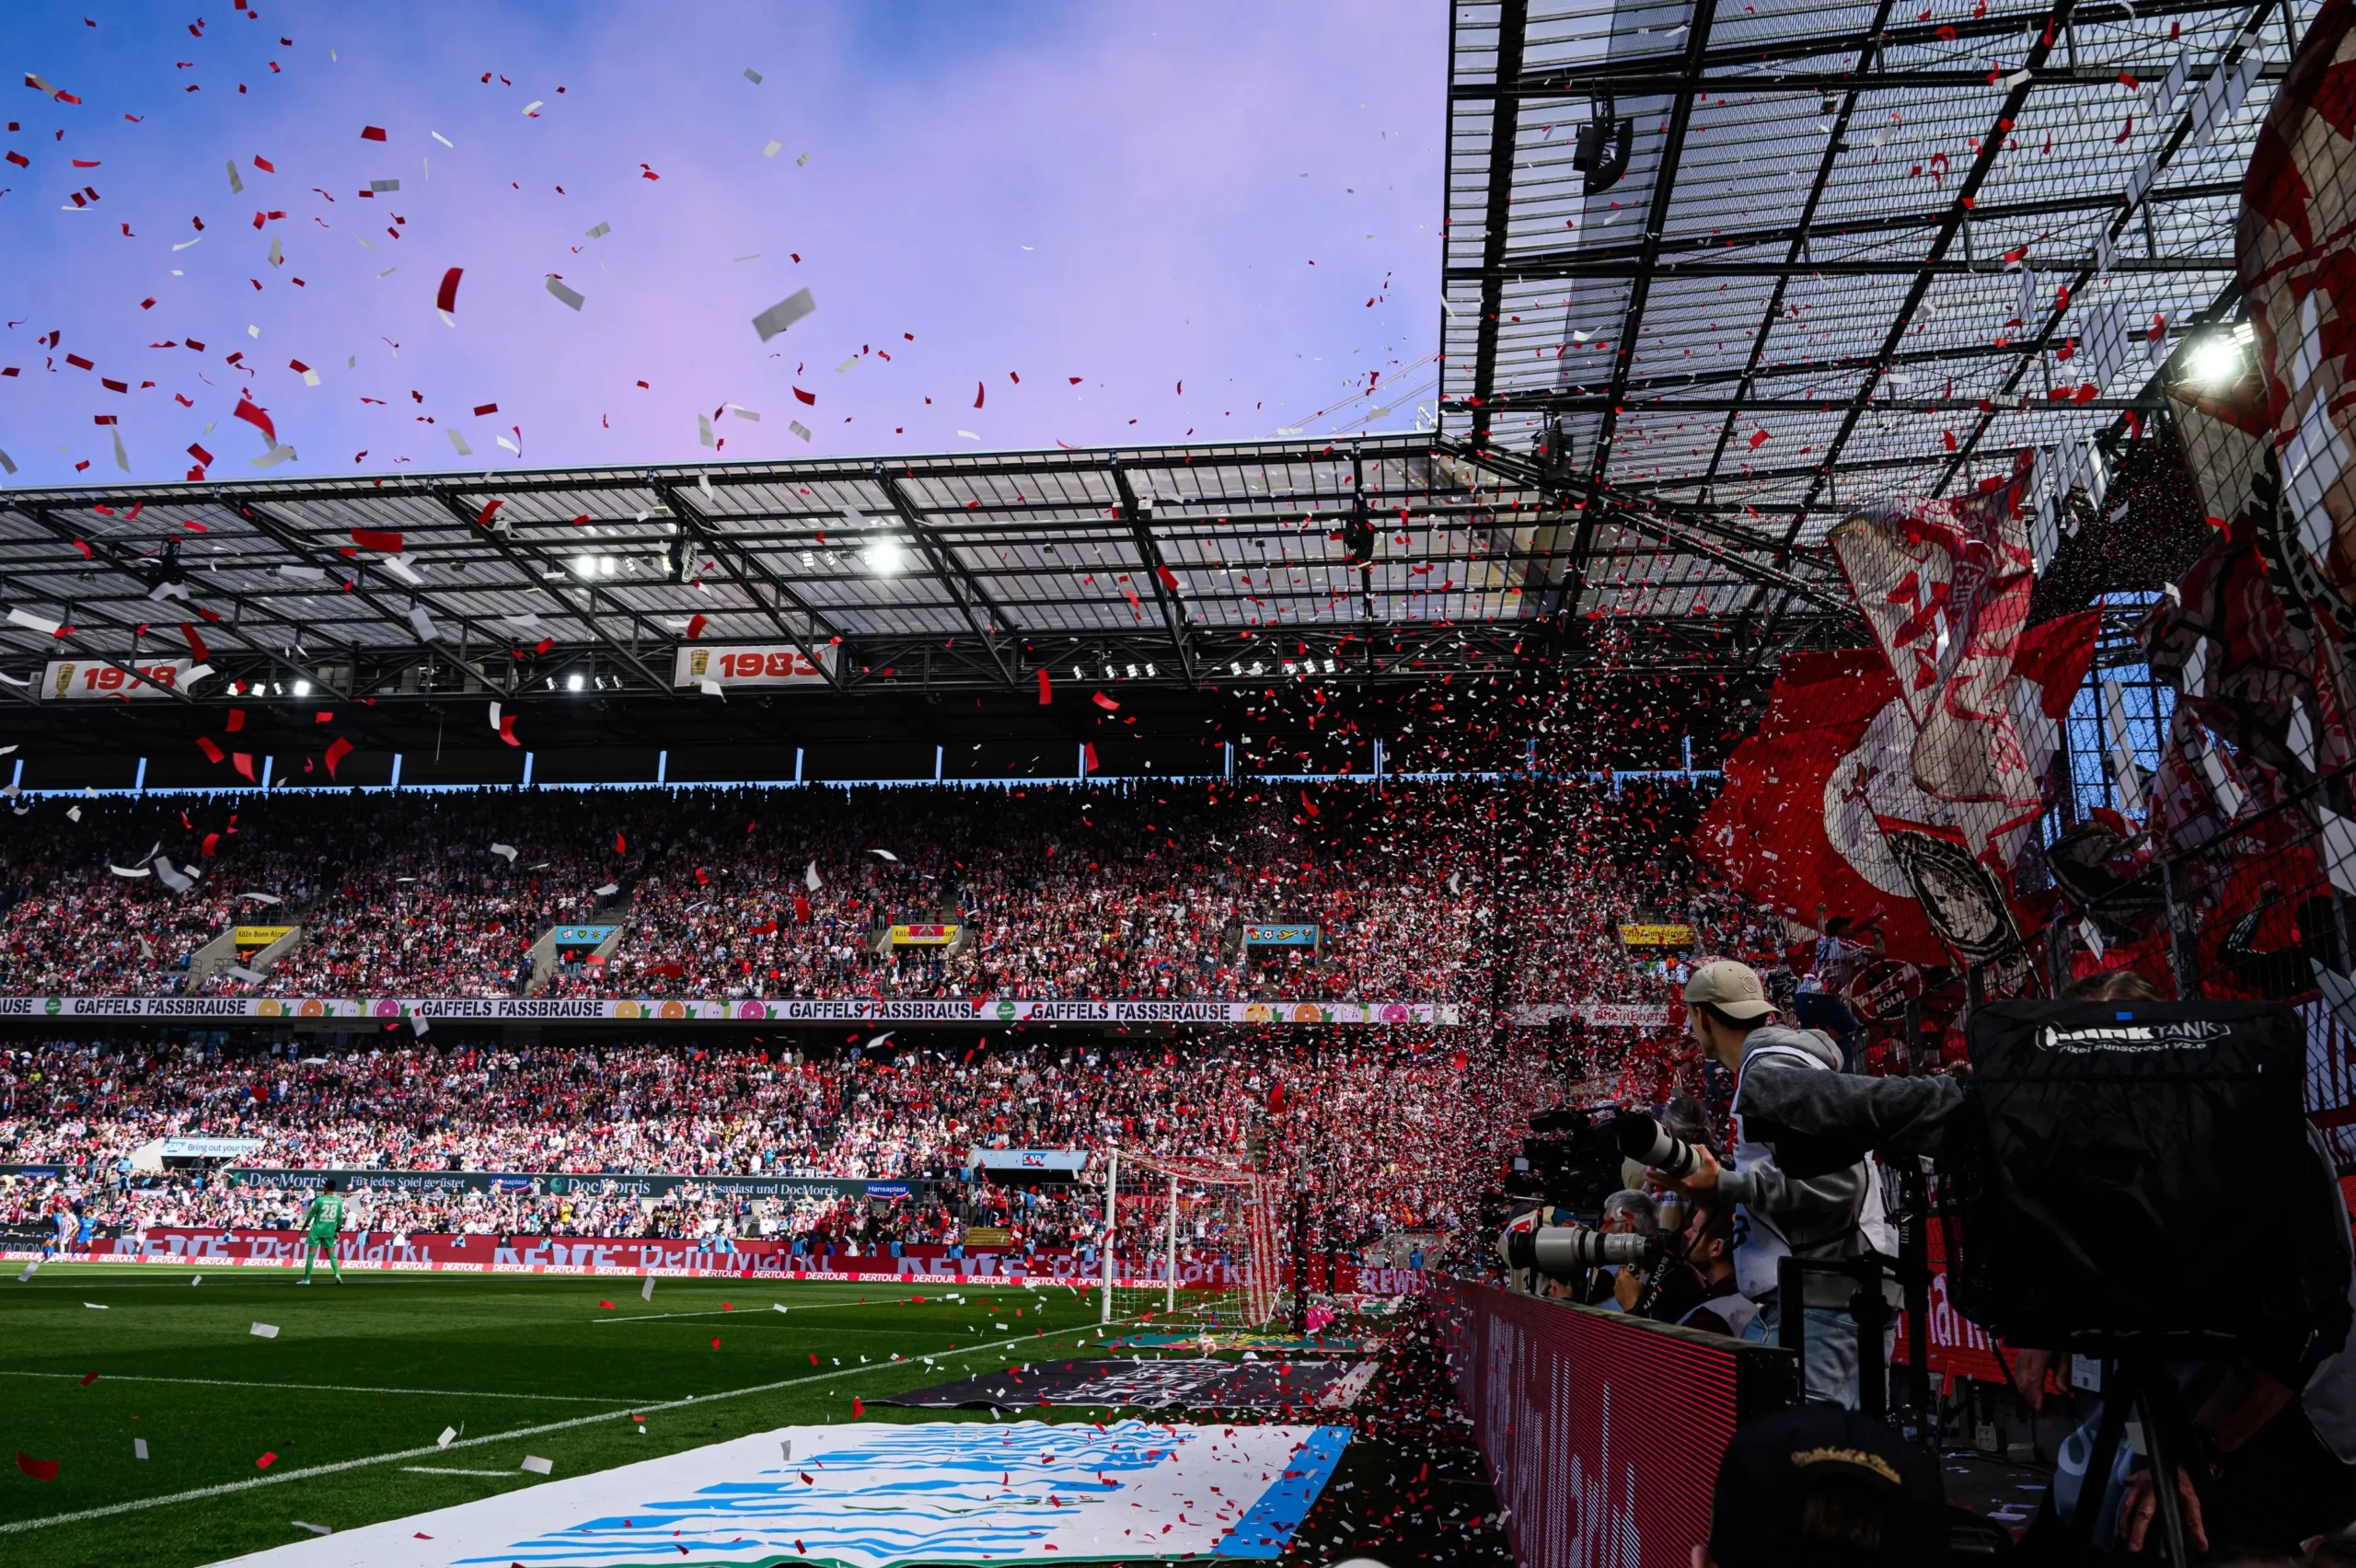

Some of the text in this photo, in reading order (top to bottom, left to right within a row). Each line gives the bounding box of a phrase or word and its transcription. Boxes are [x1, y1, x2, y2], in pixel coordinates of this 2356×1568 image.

[720, 652, 823, 677] 1983
[84, 666, 177, 690] 1978
[75, 999, 247, 1014] GAFFELS FASSBRAUSE
[421, 1001, 604, 1016] GAFFELS FASSBRAUSE
[1876, 990, 1906, 1014] KÖLN
[789, 1002, 981, 1019] GAFFELS FASSBRAUSE
[1032, 1003, 1230, 1020] GAFFELS FASSBRAUSE
[188, 1143, 207, 1153] Bring
[222, 1145, 240, 1154] your
[369, 1176, 395, 1188] jedes
[398, 1177, 422, 1189] Spiel
[423, 1178, 465, 1190] gerüstet
[491, 1178, 527, 1186] Hsaplast
[756, 1184, 778, 1193] und
[780, 1183, 838, 1194] DocMorris
[868, 1185, 907, 1193] Hansaplast
[319, 1205, 338, 1219] 28
[4, 1251, 44, 1261] DERTOUR
[145, 1255, 186, 1264] DERTOUR
[194, 1256, 235, 1266] DERTOUR
[243, 1258, 283, 1267] DERTOUR
[292, 1259, 332, 1269] DEOUR
[341, 1260, 382, 1270] DERTOUR
[390, 1261, 433, 1271] DERTOUR
[442, 1262, 483, 1272] DERTOUR
[492, 1264, 534, 1274] DERTOUR
[543, 1265, 585, 1274] DERTOUR
[595, 1266, 637, 1275] DERTOUR
[647, 1267, 688, 1277] DERTOUR
[699, 1269, 741, 1278] DERTOUR
[752, 1270, 795, 1280] DERTOUR
[805, 1272, 848, 1281] DERTOUR
[859, 1273, 902, 1283] DERTOUR
[913, 1274, 956, 1284] DERTOUR
[967, 1275, 1011, 1285] DERTOUR
[1022, 1277, 1066, 1286] DERTOUR
[1078, 1278, 1122, 1288] DERTR
[1053, 1254, 1130, 1280] Den
[1649, 1256, 1669, 1288] SONY
